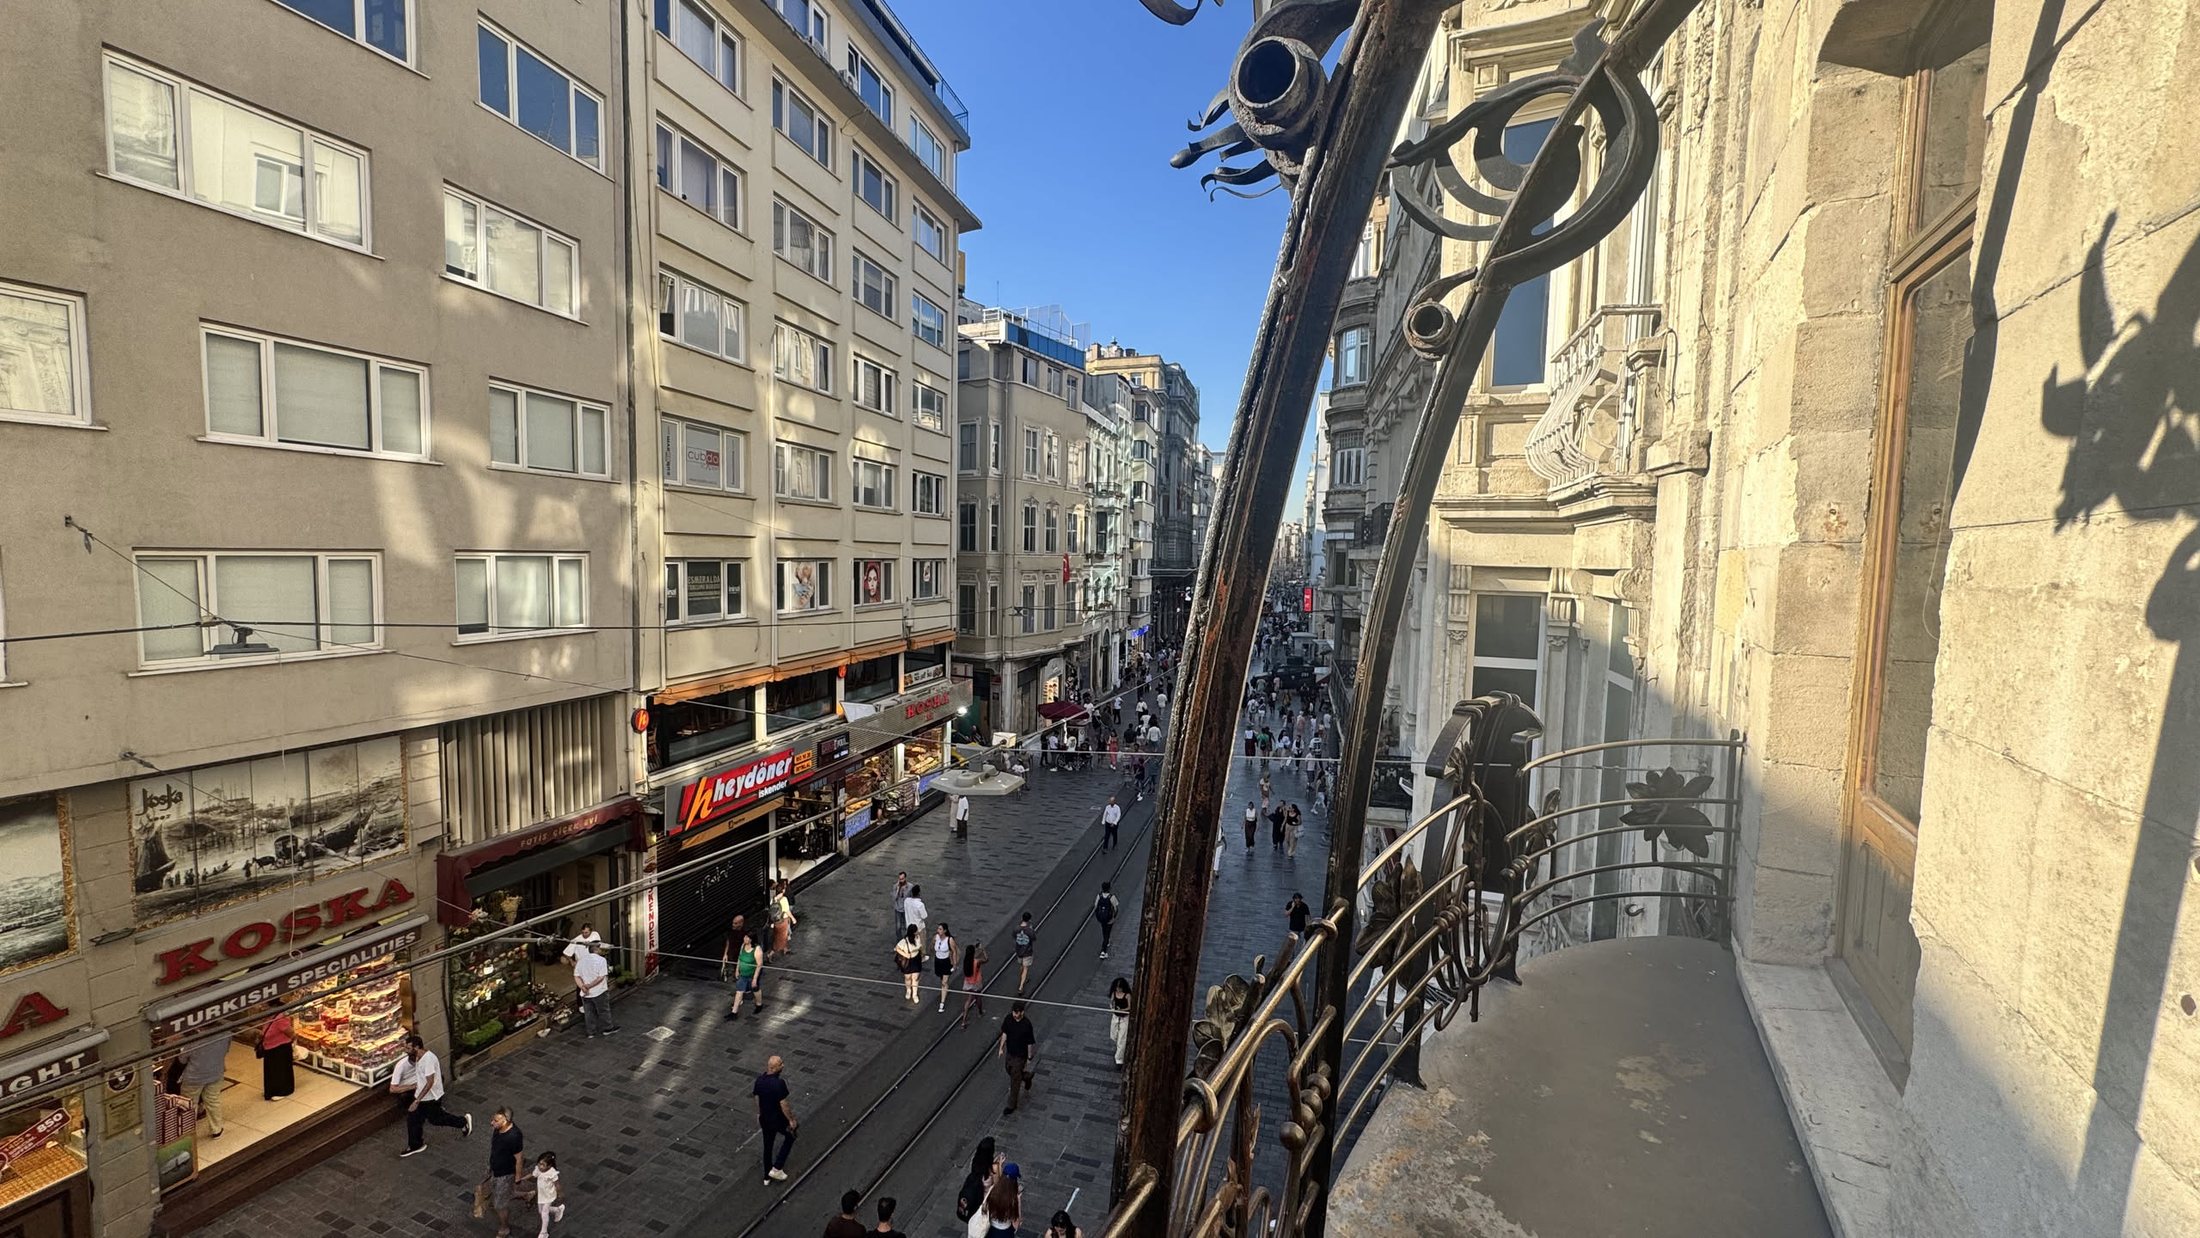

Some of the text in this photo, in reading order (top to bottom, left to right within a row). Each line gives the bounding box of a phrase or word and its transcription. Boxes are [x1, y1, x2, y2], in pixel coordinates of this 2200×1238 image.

[713, 756, 793, 803] heydöner
[157, 878, 415, 986] KOSKA
[170, 931, 416, 1033] TURKISH SPECIALITIES
[36, 1112, 64, 1133] 850
